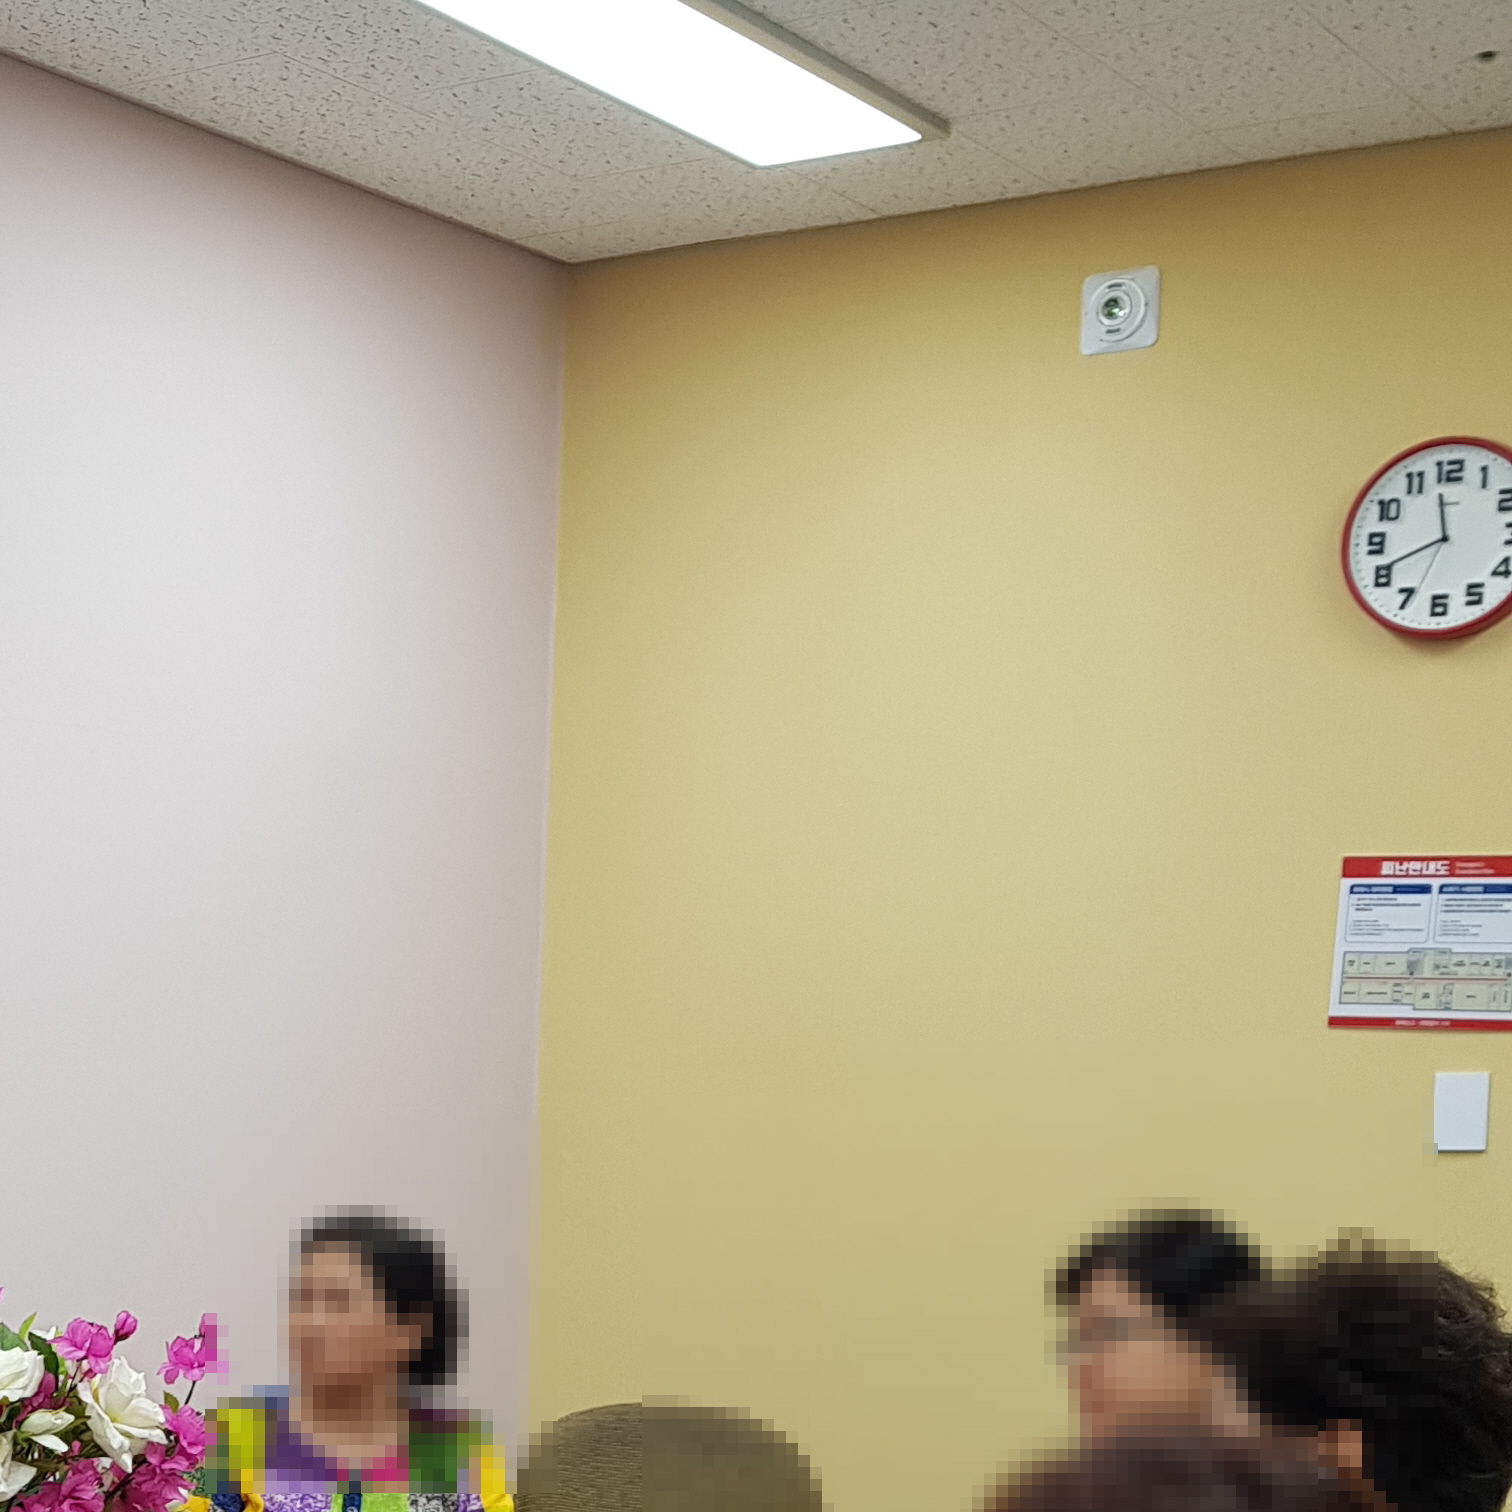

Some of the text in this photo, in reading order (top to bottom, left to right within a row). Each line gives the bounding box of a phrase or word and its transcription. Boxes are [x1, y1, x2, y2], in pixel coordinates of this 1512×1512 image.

[1405, 470, 1426, 495] 11
[1435, 458, 1466, 484] 12
[1479, 464, 1489, 489] 1
[1377, 497, 1401, 522] 10
[1497, 487, 1512, 512] 2
[1366, 531, 1387, 556] 9
[1373, 563, 1393, 588] 8
[1490, 556, 1512, 579] 4
[1397, 586, 1416, 610] 7
[1429, 593, 1450, 617] 6
[1464, 582, 1485, 606] 5
